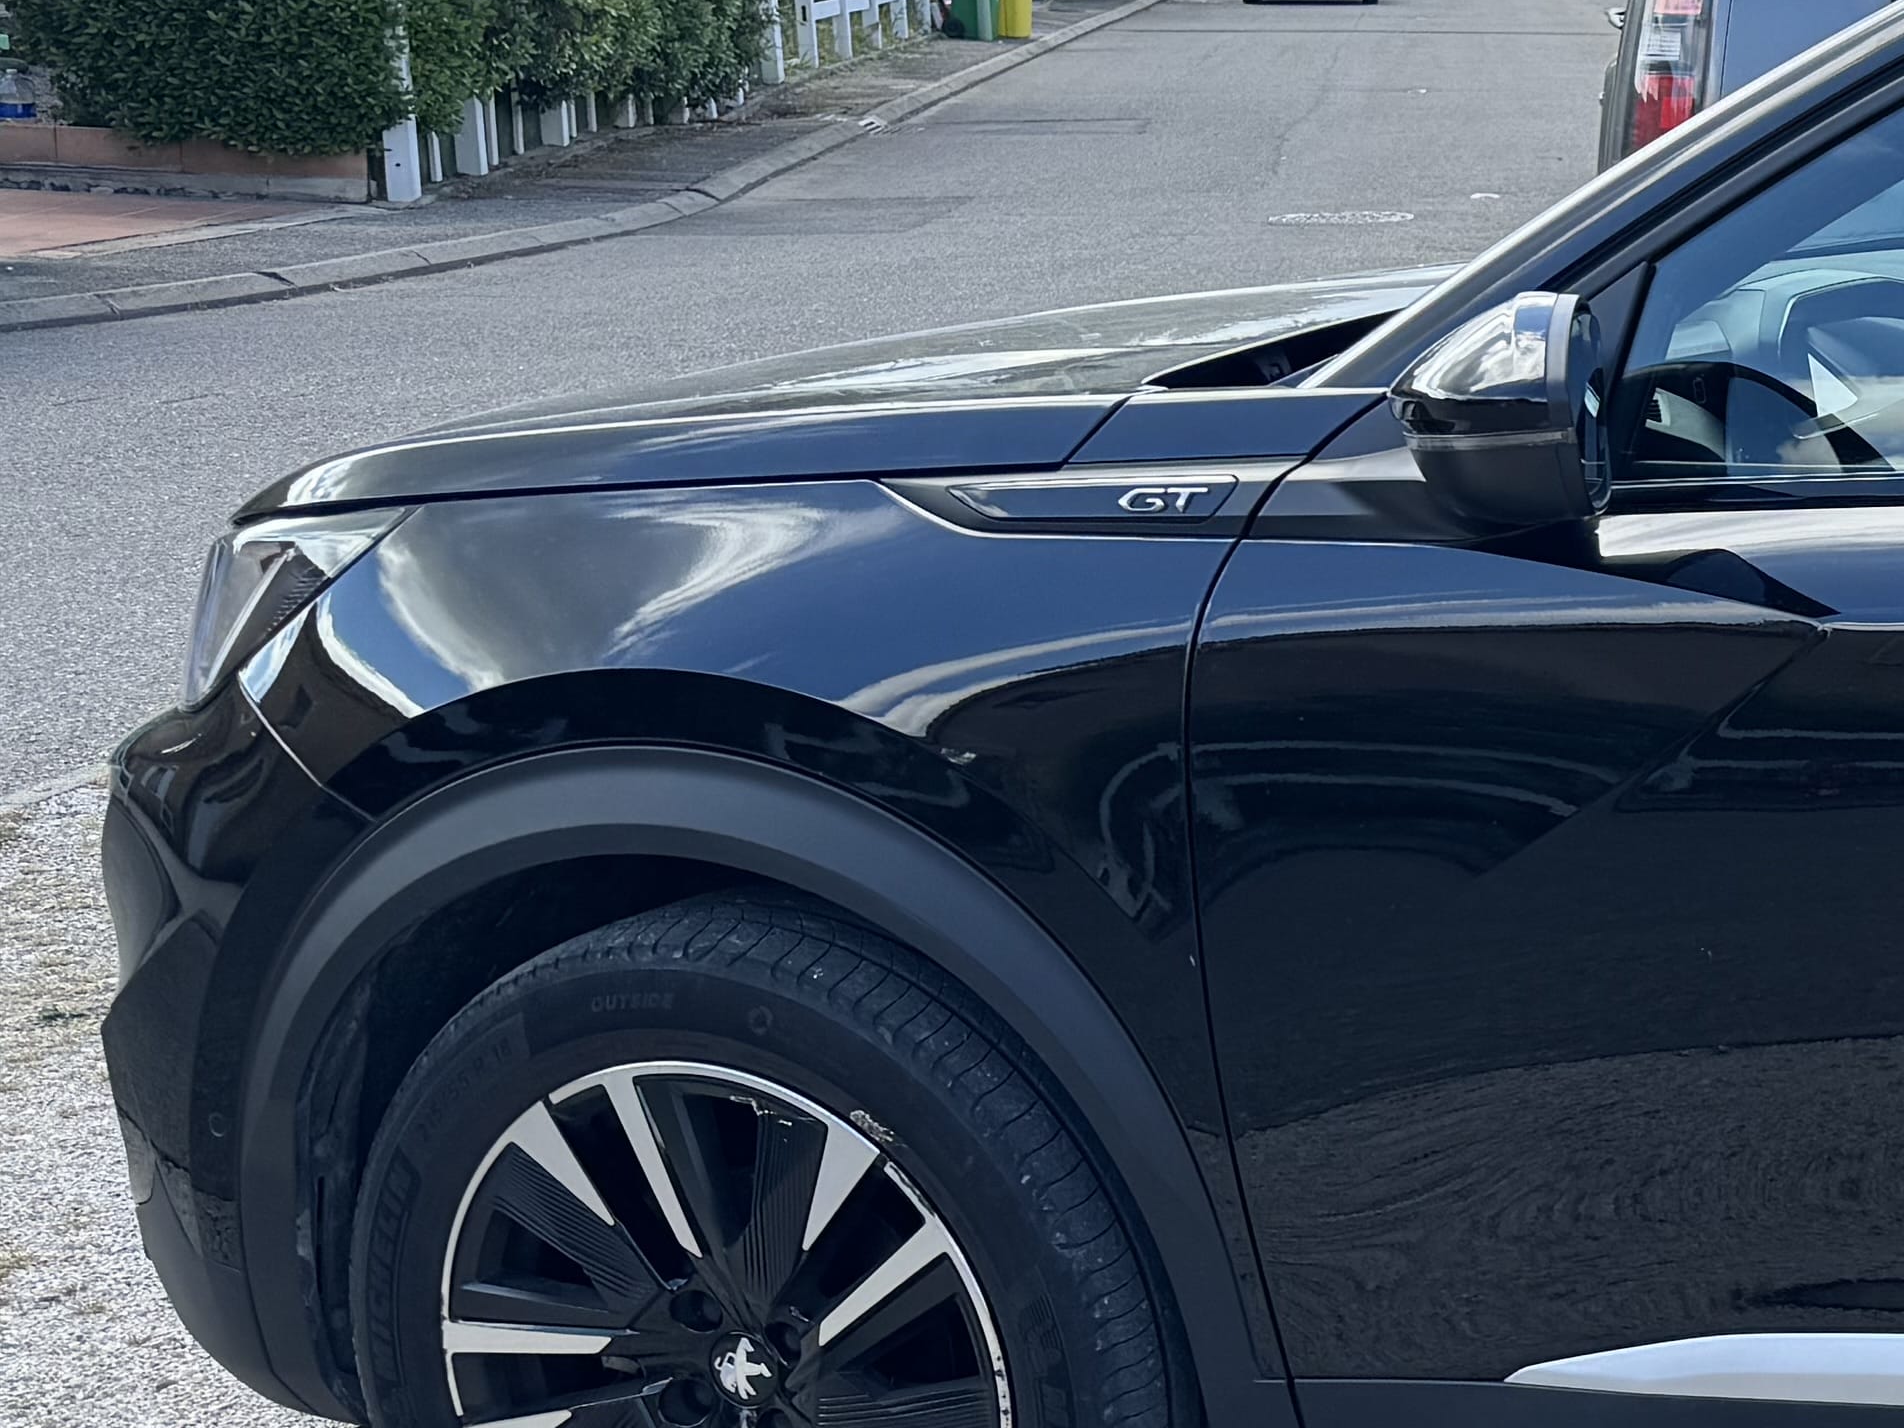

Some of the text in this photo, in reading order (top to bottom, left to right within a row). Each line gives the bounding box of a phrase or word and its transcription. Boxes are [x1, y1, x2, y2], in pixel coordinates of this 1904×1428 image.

[1118, 487, 1209, 514] GT
[591, 992, 675, 1013] OUTSIDE
[369, 1159, 411, 1382] MICHELIN
